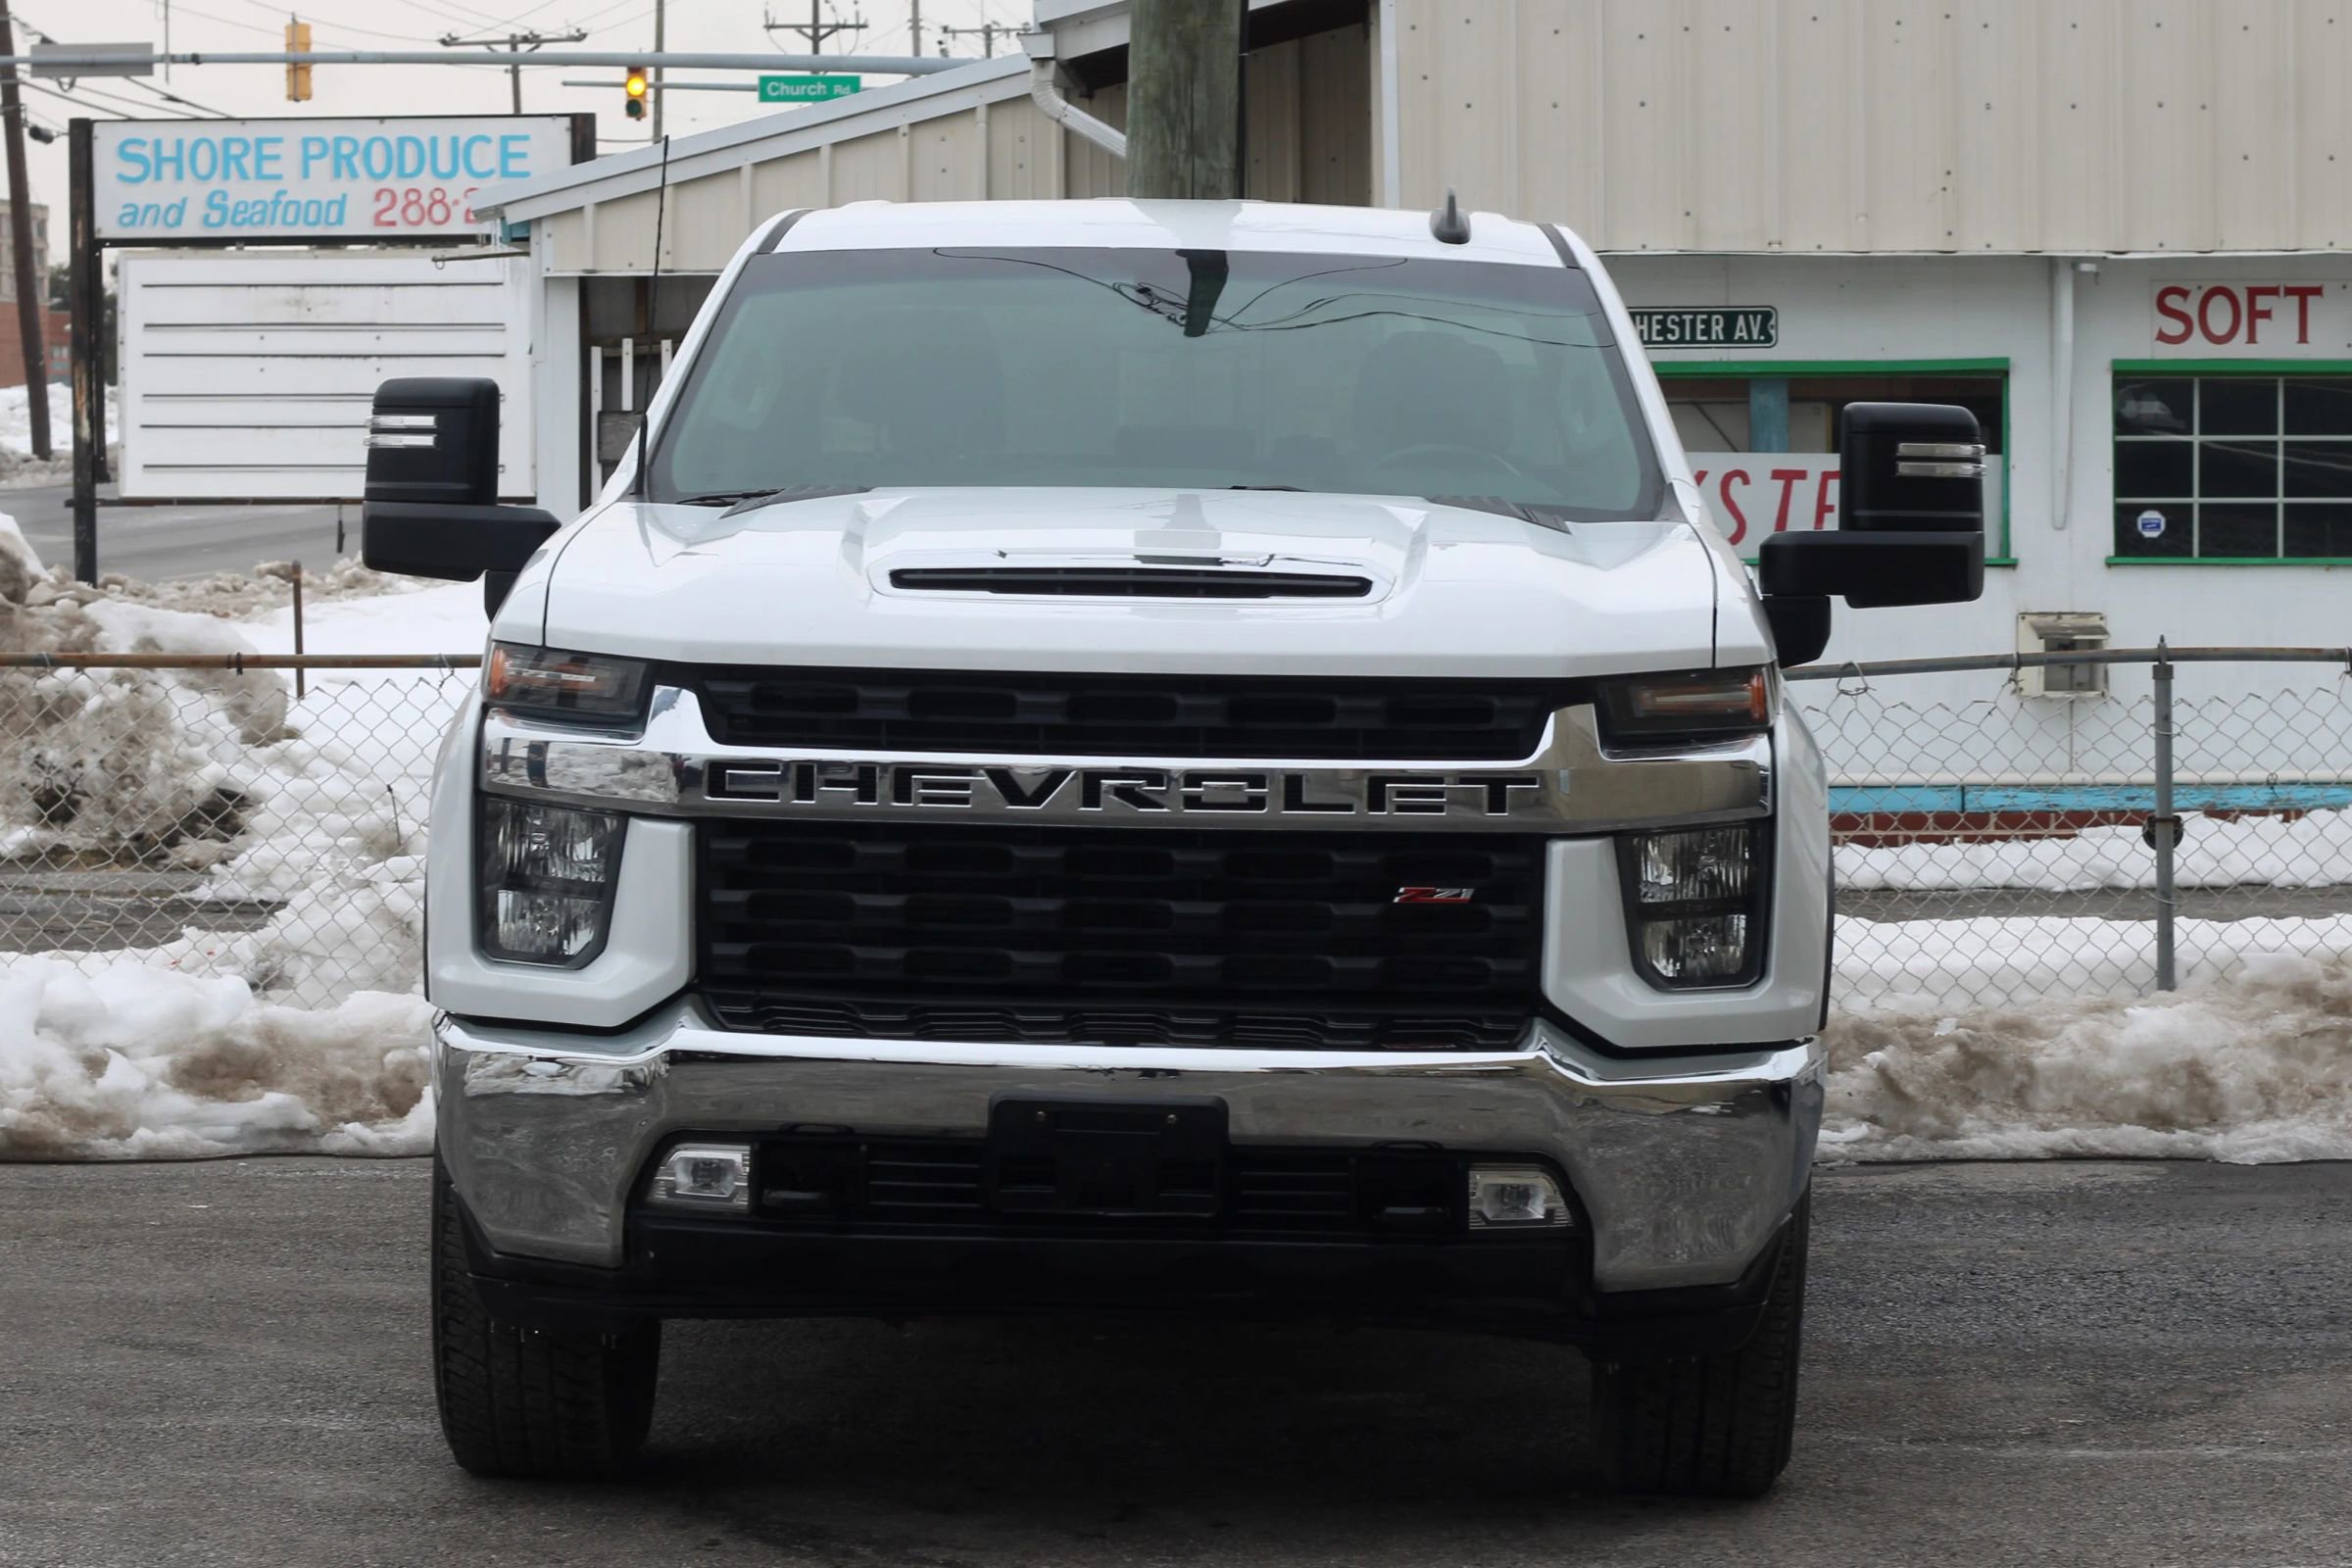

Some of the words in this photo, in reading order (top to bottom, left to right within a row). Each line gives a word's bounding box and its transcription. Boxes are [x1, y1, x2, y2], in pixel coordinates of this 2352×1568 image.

[767, 81, 827, 96] Church
[116, 137, 283, 183] SHORE
[301, 134, 531, 179] PRODUCE
[118, 197, 188, 227] and
[203, 189, 348, 227] Seafood
[1635, 315, 1725, 341] HESTER
[1734, 314, 1765, 341] AV.
[2155, 285, 2324, 345] SOFT
[704, 760, 1540, 816] CHEVROLET
